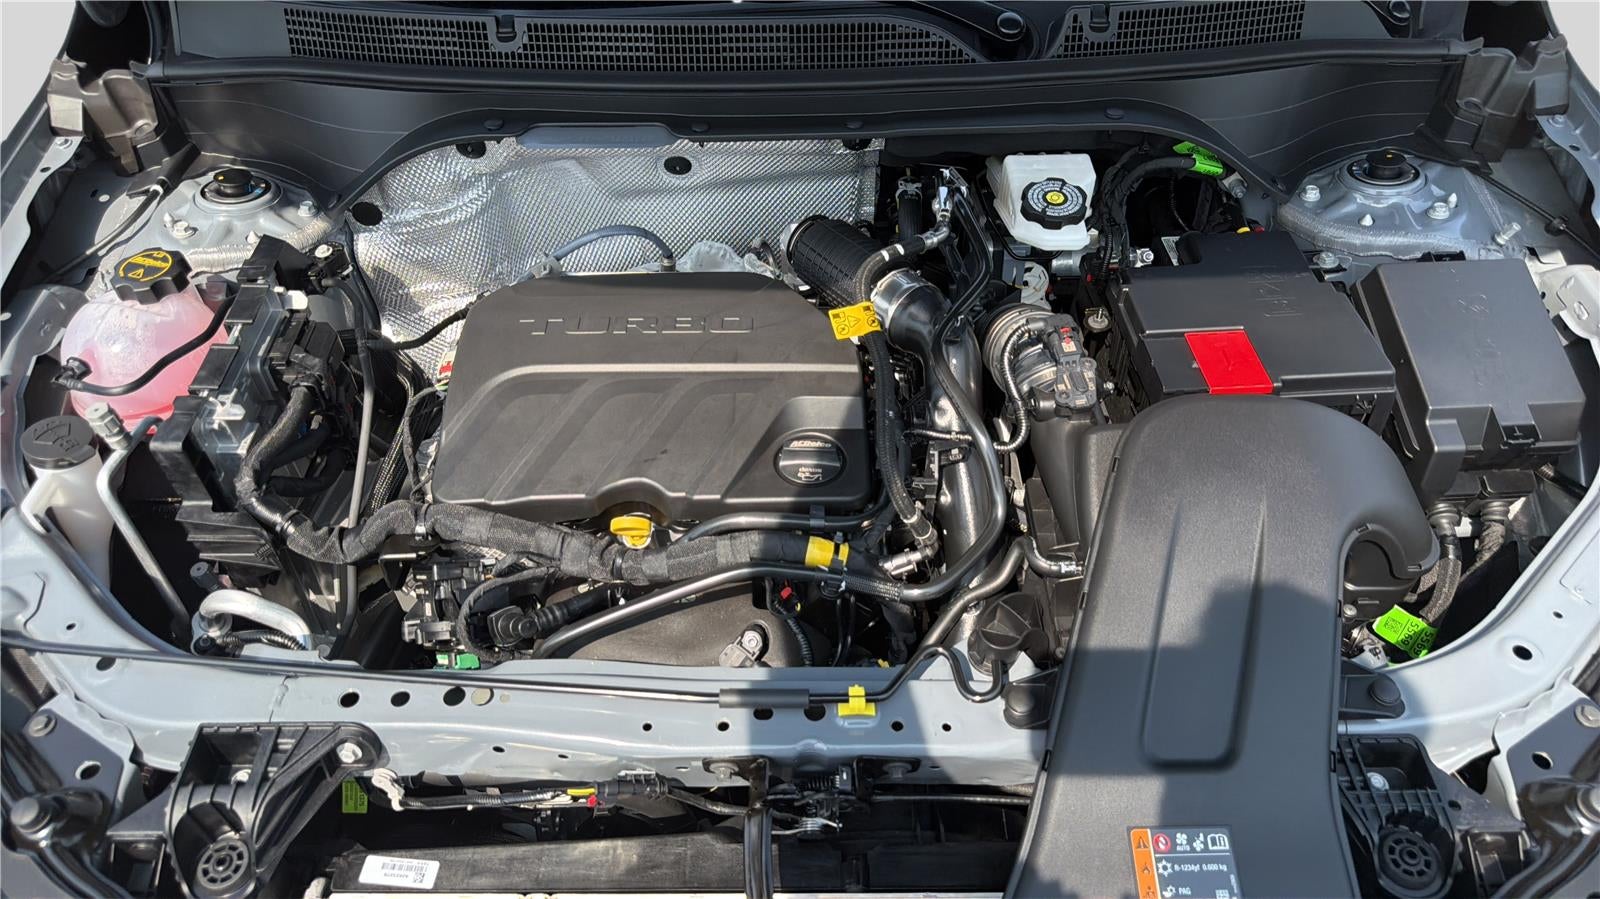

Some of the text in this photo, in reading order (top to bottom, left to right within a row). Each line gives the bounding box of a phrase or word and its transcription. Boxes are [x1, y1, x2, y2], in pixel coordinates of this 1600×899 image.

[519, 317, 754, 335] TURBO
[1401, 621, 1419, 646] 5569
[1178, 887, 1192, 895] PAG
